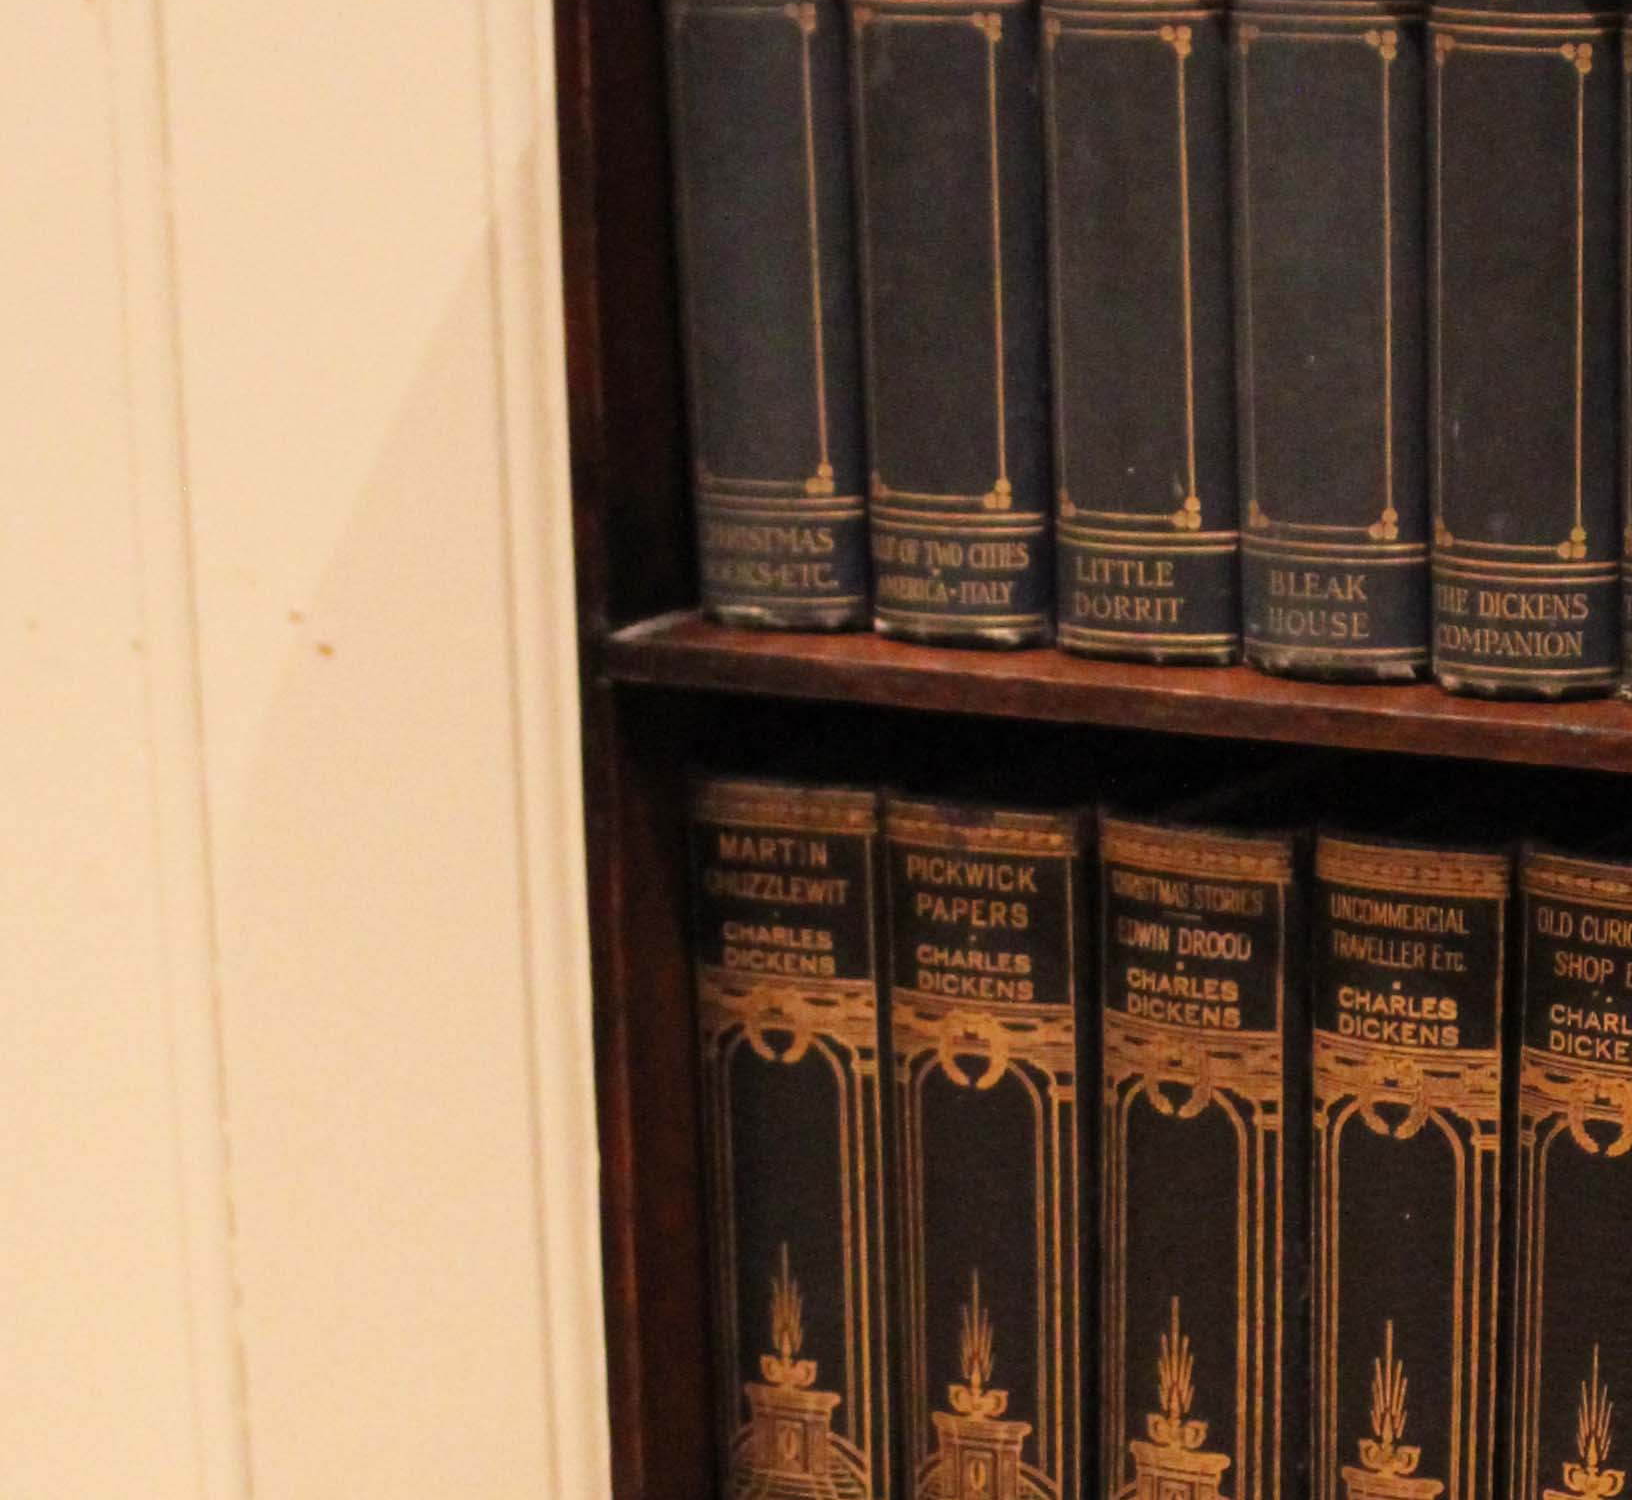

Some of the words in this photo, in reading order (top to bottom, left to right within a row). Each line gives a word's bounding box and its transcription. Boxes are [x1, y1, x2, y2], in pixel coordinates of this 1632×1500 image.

[969, 543, 1029, 569] CITIES
[1075, 556, 1174, 587] LITTLE
[1269, 570, 1368, 600] BLEAK
[1074, 590, 1184, 623] DORRIT
[1479, 590, 1589, 620] DICKENS
[1269, 606, 1369, 638] HOUSE
[1437, 626, 1584, 657] COMPANION
[719, 834, 828, 867] MARTIN
[906, 854, 1038, 893] PICKWICK
[915, 892, 1029, 929] PAPERS
[1329, 893, 1469, 935] UNCOMMERCIAL
[1537, 906, 1573, 939] OLD
[723, 921, 833, 951] CHARLES
[1177, 926, 1252, 961] DROOD
[1330, 929, 1425, 971] TRAVELLER
[723, 946, 836, 977] DICKENS
[916, 943, 1031, 974] CHARLES
[1553, 951, 1615, 986] SHOP
[916, 969, 1034, 1001] DICKENS
[1125, 967, 1240, 1003] CHARLES
[1127, 993, 1241, 1029] DICKENS
[1337, 985, 1458, 1021] CHARLES
[1338, 1012, 1460, 1047] DICKENS
